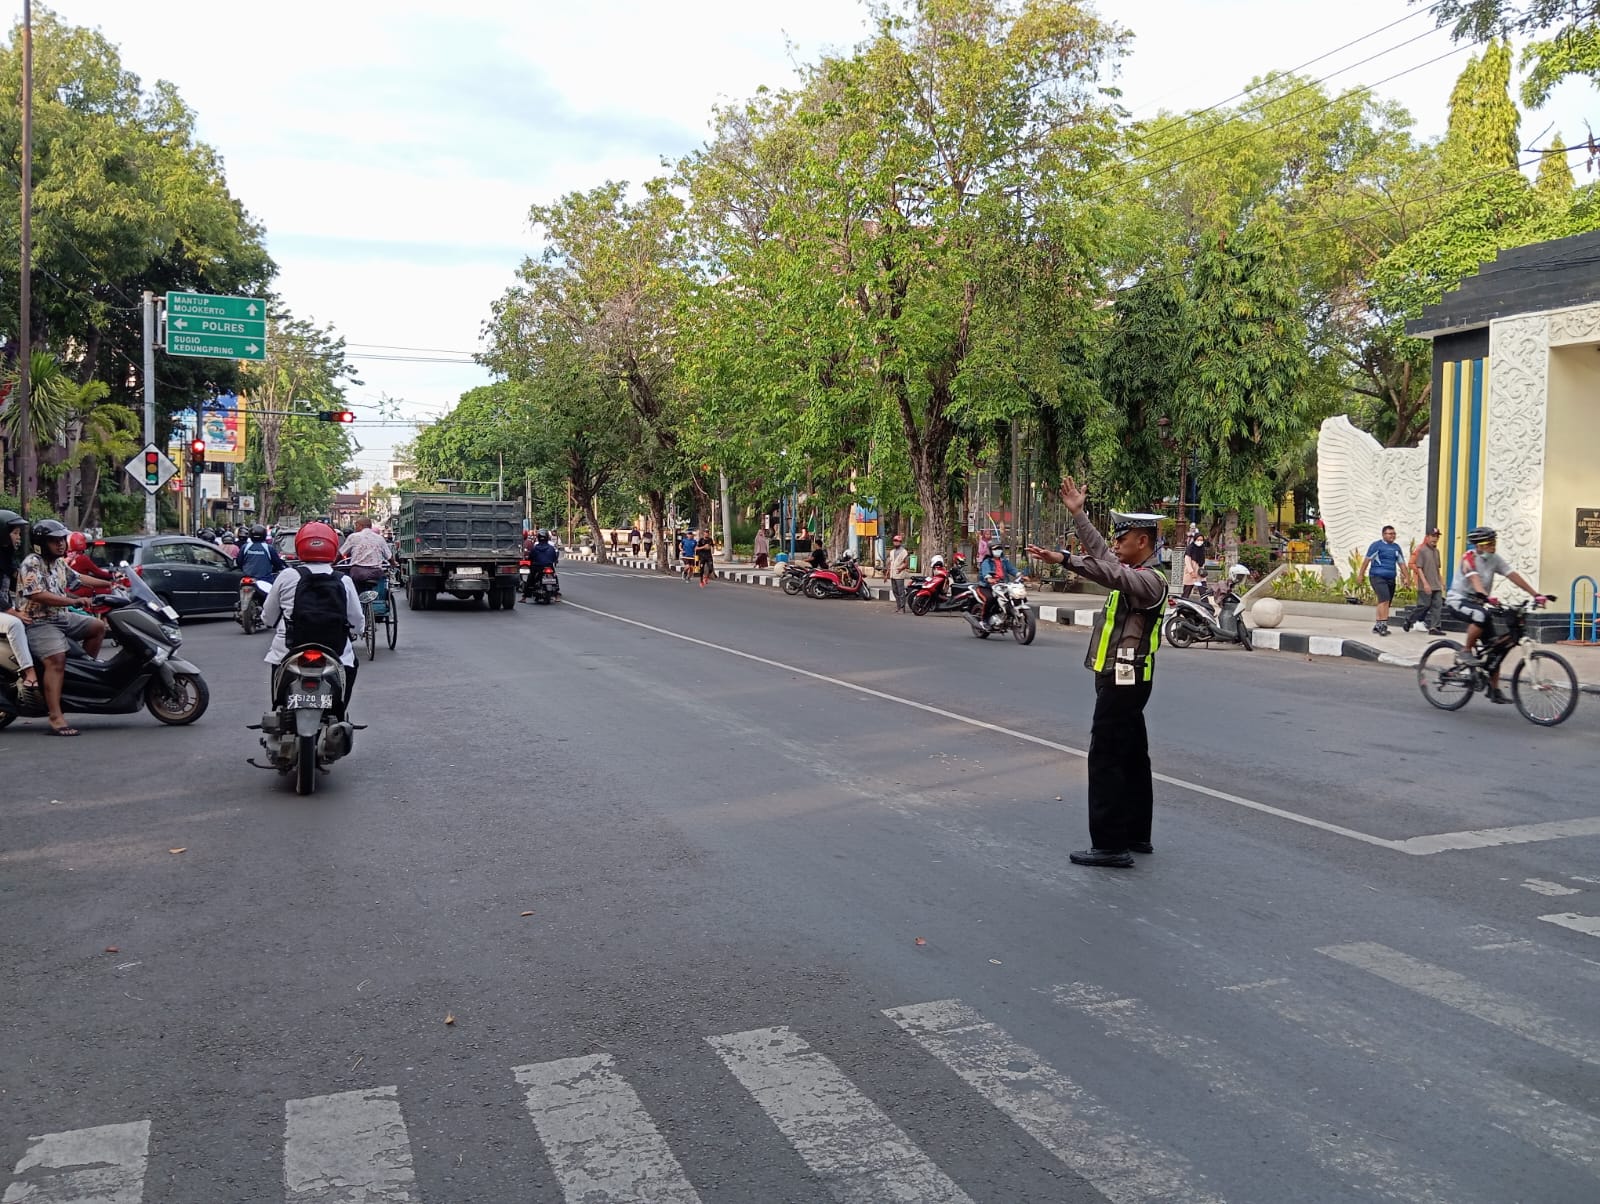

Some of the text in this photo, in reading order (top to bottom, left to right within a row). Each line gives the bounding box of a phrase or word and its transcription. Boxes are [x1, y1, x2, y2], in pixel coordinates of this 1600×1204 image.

[174, 296, 210, 305] MANTUP
[174, 304, 225, 315] MOJOKERTO
[202, 321, 244, 332] POLRES
[174, 335, 201, 344] SUGIO
[174, 344, 233, 355] KEDUNGPRING
